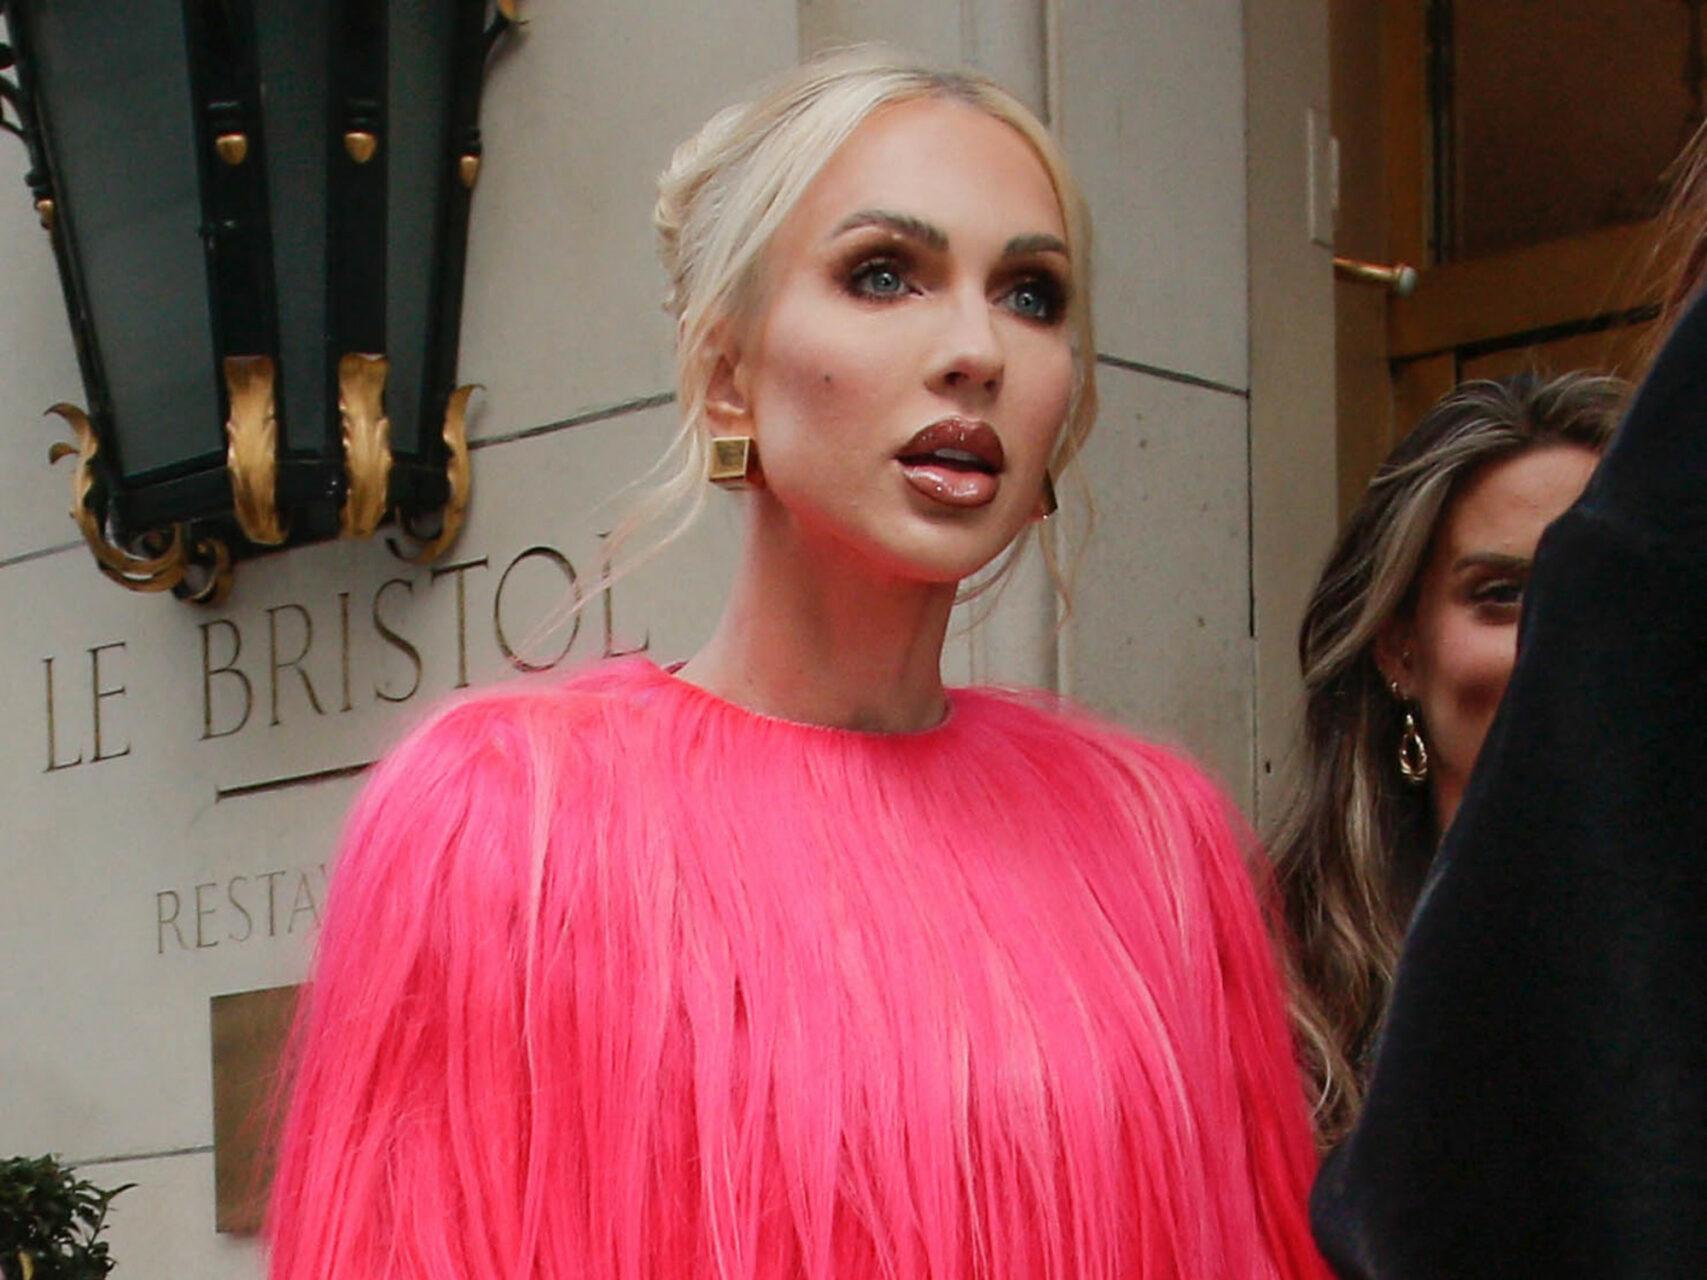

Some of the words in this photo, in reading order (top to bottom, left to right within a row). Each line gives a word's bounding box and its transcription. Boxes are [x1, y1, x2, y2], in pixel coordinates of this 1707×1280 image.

[42, 641, 132, 773] LE
[197, 532, 650, 741] BRISTOL
[156, 863, 329, 955] RESTA
